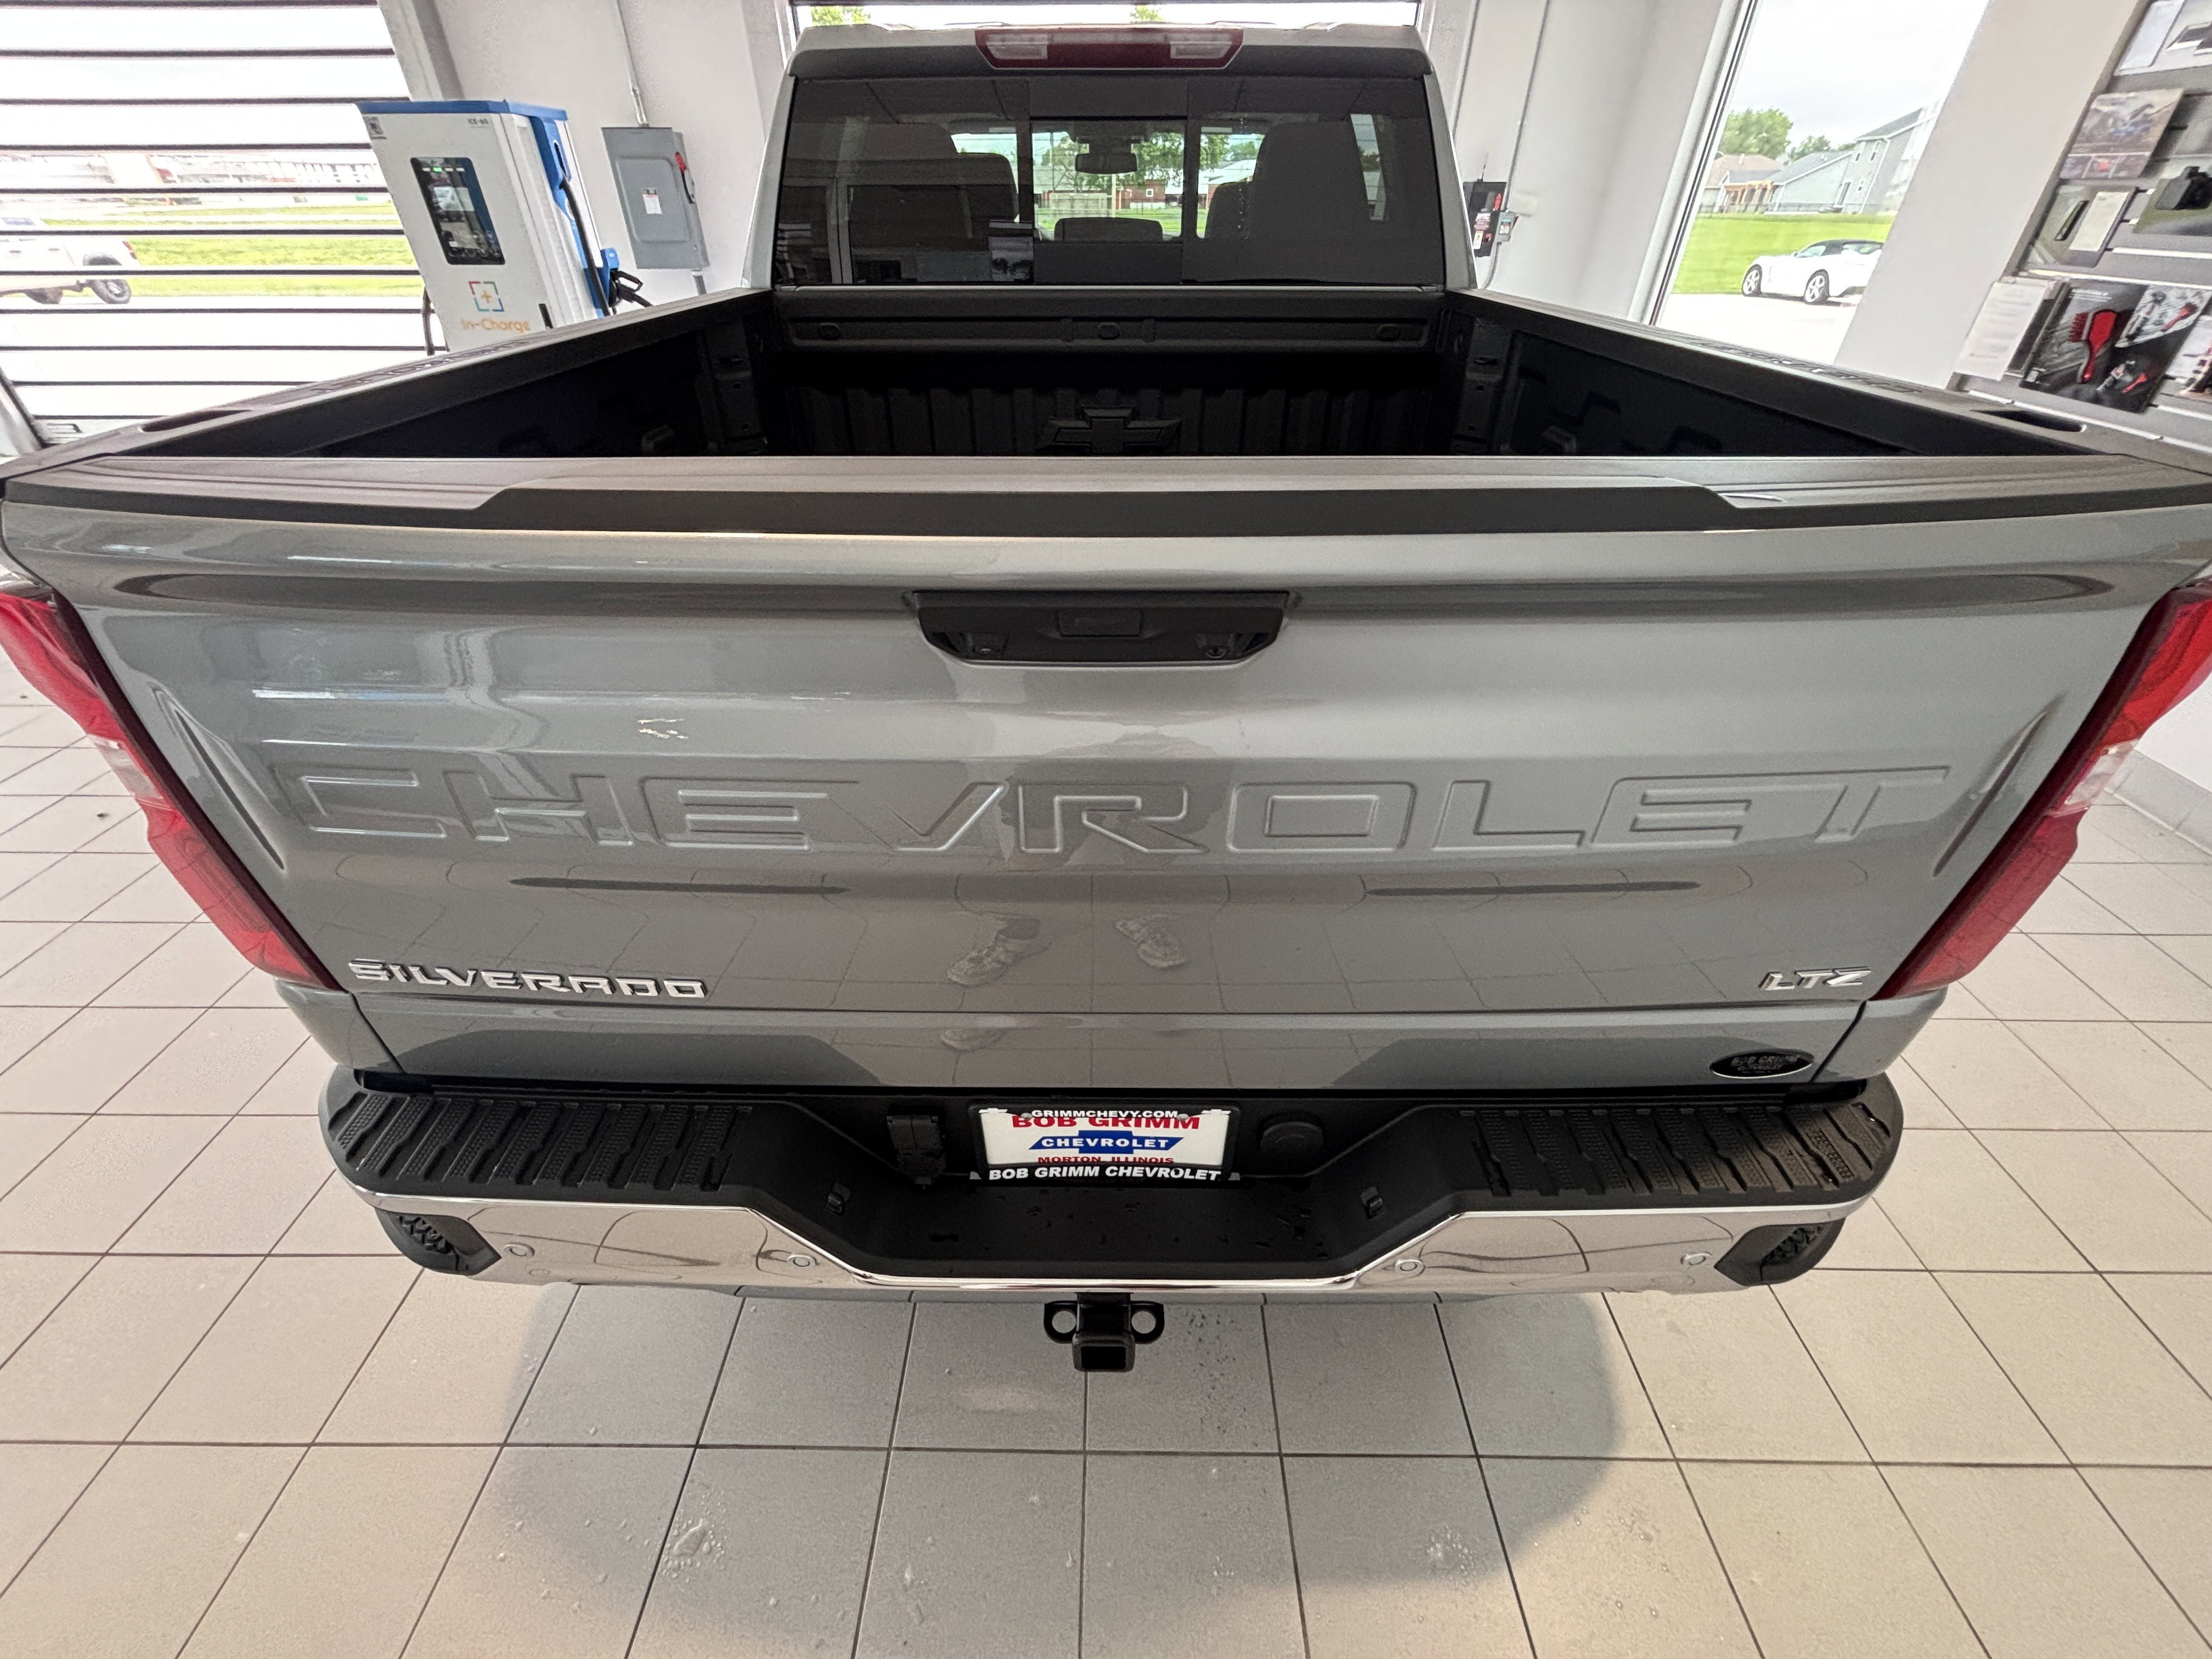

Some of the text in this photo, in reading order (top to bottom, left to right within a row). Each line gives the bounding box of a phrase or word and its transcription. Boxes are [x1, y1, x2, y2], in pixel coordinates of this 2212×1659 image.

[461, 318, 531, 333] In-Charge
[272, 764, 1950, 854] CHEVROLET
[348, 958, 707, 998] SILVERADO
[1759, 966, 1871, 991] LTZ
[1031, 1110, 1178, 1119] GRIMMCHEVY.COM
[1012, 1116, 1200, 1130] BOB GRIMM
[1041, 1138, 1169, 1148] CHEVROLET
[1038, 1156, 1101, 1164] MORTON
[989, 1166, 1222, 1181] BOB GRIMM CHEVROLET
